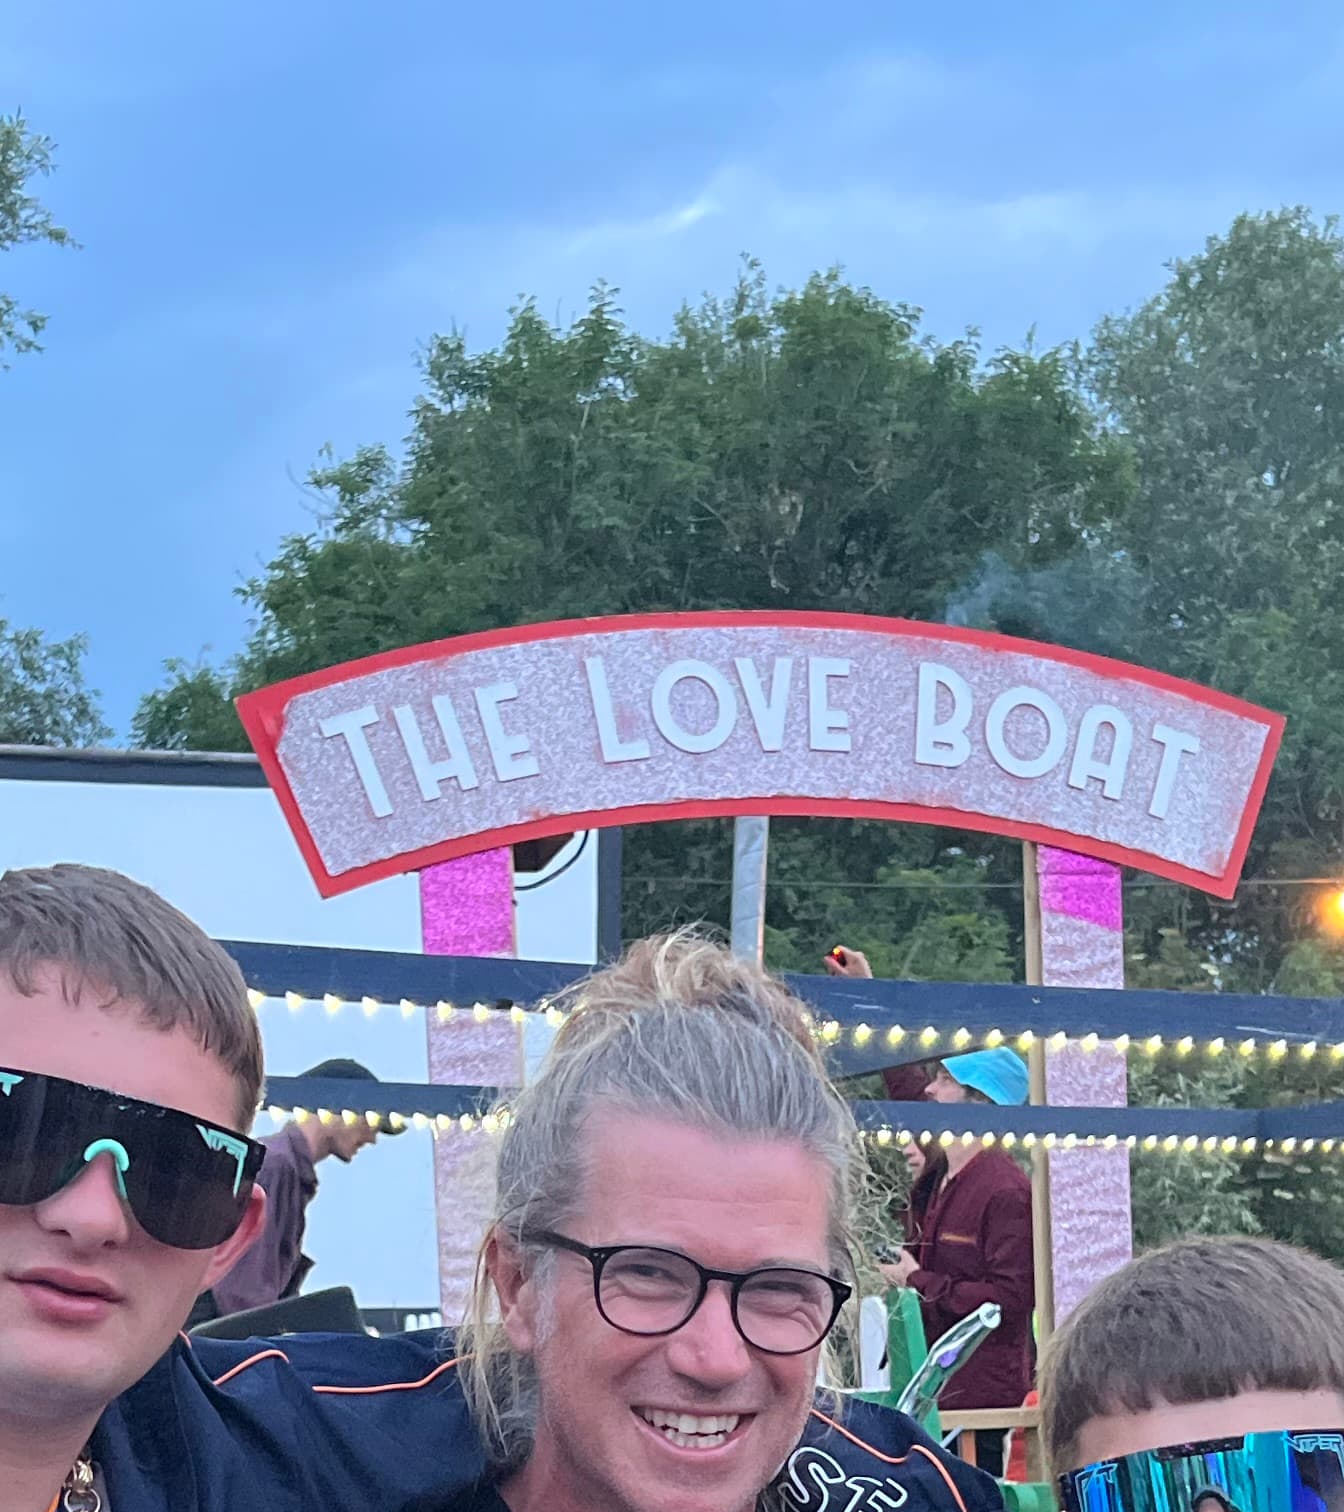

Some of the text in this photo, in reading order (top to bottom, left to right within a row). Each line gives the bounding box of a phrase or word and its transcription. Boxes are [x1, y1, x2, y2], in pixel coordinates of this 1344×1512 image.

[319, 657, 1201, 819] THE LOVE BOAT
